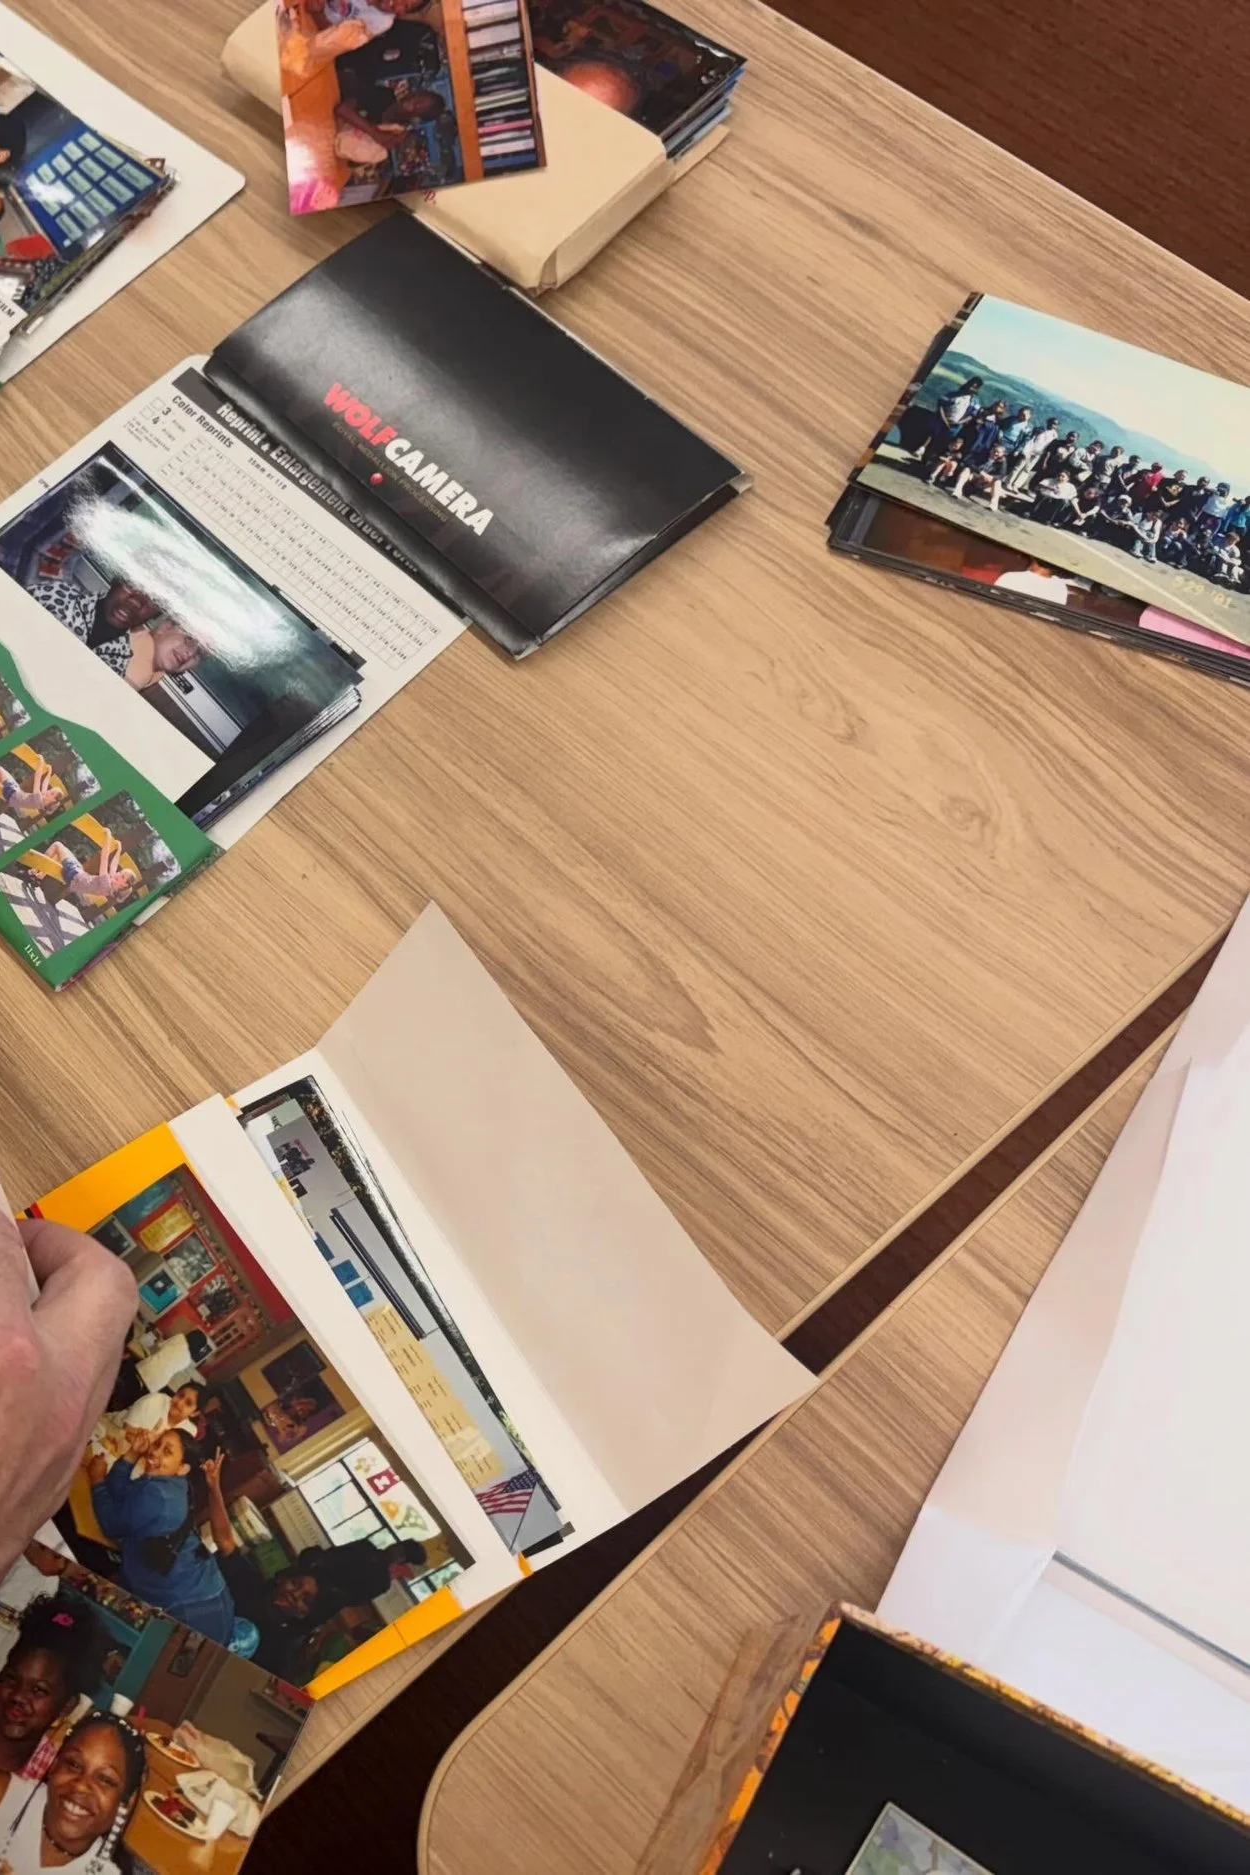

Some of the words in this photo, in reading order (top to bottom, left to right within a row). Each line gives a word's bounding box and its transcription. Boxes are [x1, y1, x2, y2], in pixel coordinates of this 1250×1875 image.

[173, 396, 197, 416] Color
[196, 415, 233, 447] Reprints
[217, 404, 265, 445] Reprint
[25, 944, 41, 966] 11x14
